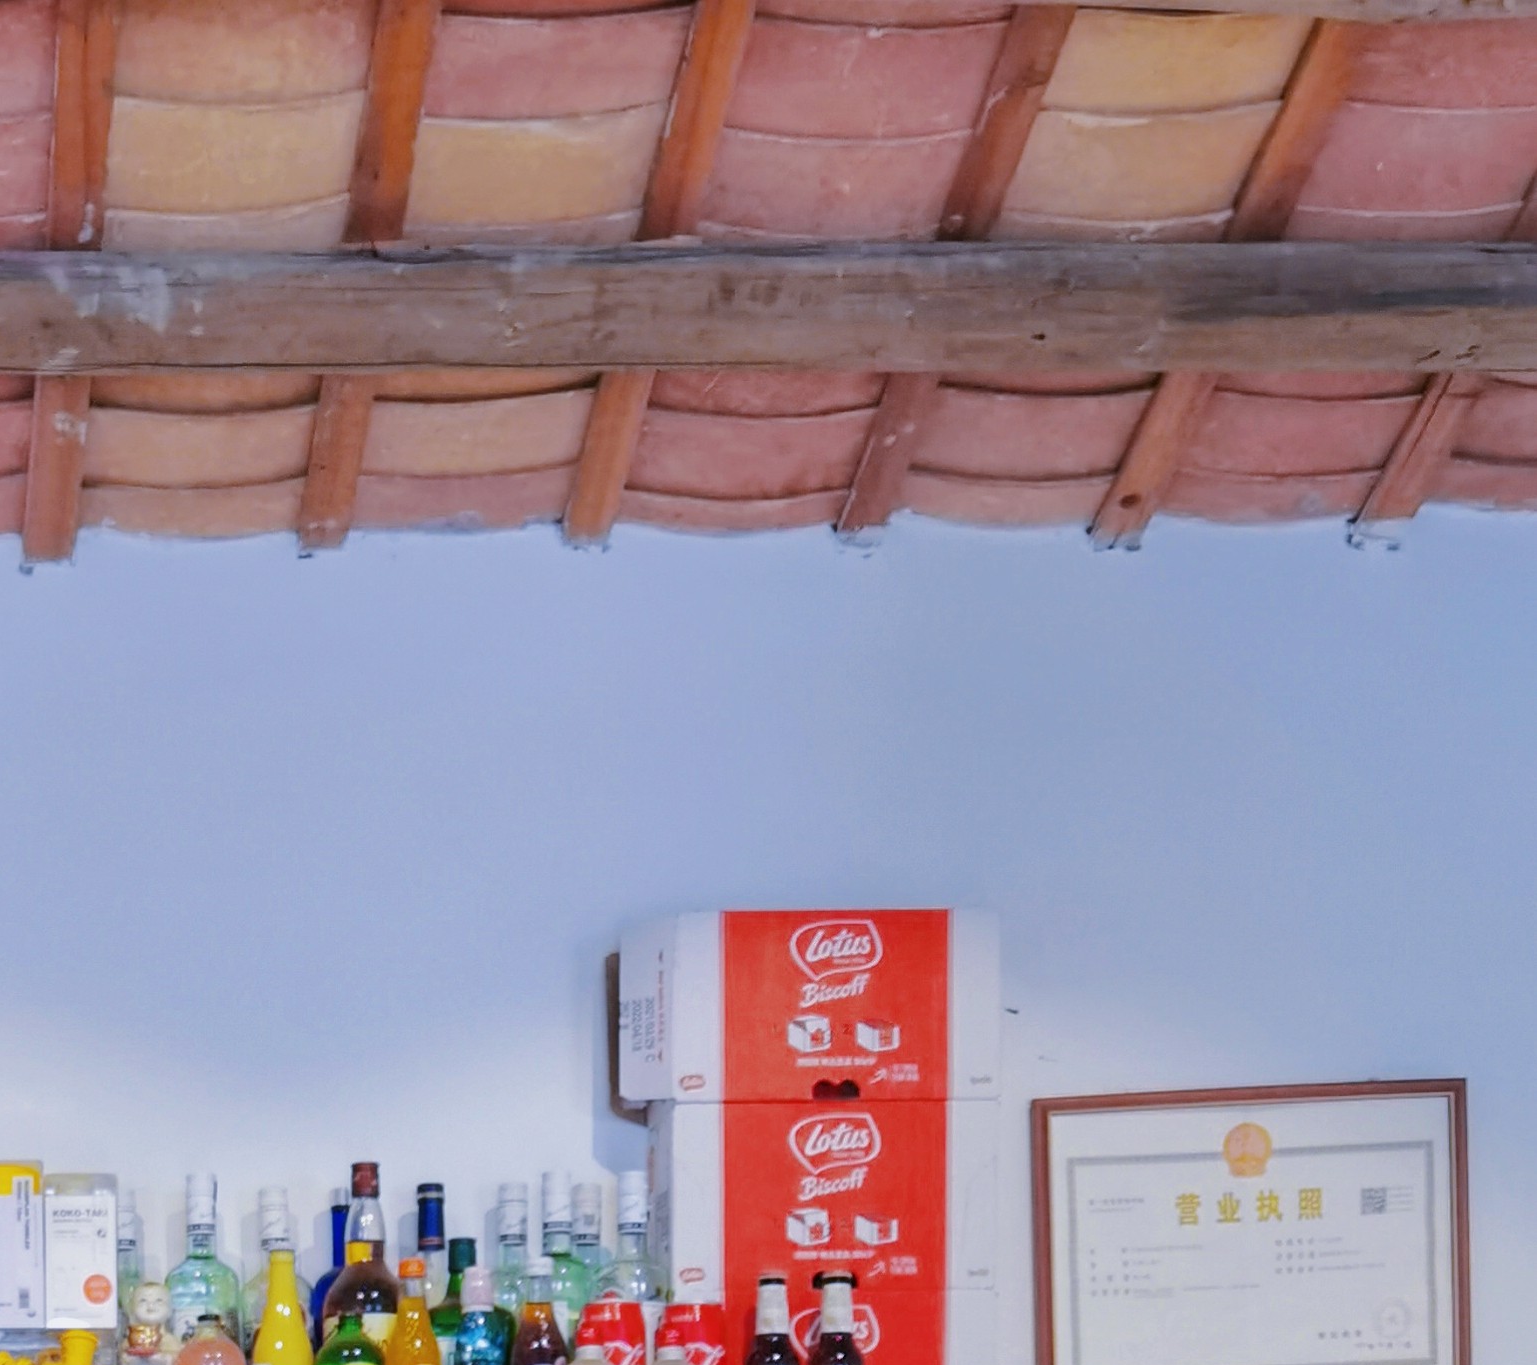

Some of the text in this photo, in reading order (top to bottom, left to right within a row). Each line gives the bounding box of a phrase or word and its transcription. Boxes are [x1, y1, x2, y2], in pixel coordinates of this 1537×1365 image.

[805, 929, 871, 962] Lotus
[799, 973, 871, 1008] Biscoff
[804, 1125, 871, 1156] Lotus
[798, 1166, 869, 1201] Biscoff
[1174, 1188, 1324, 1227] 营业执照
